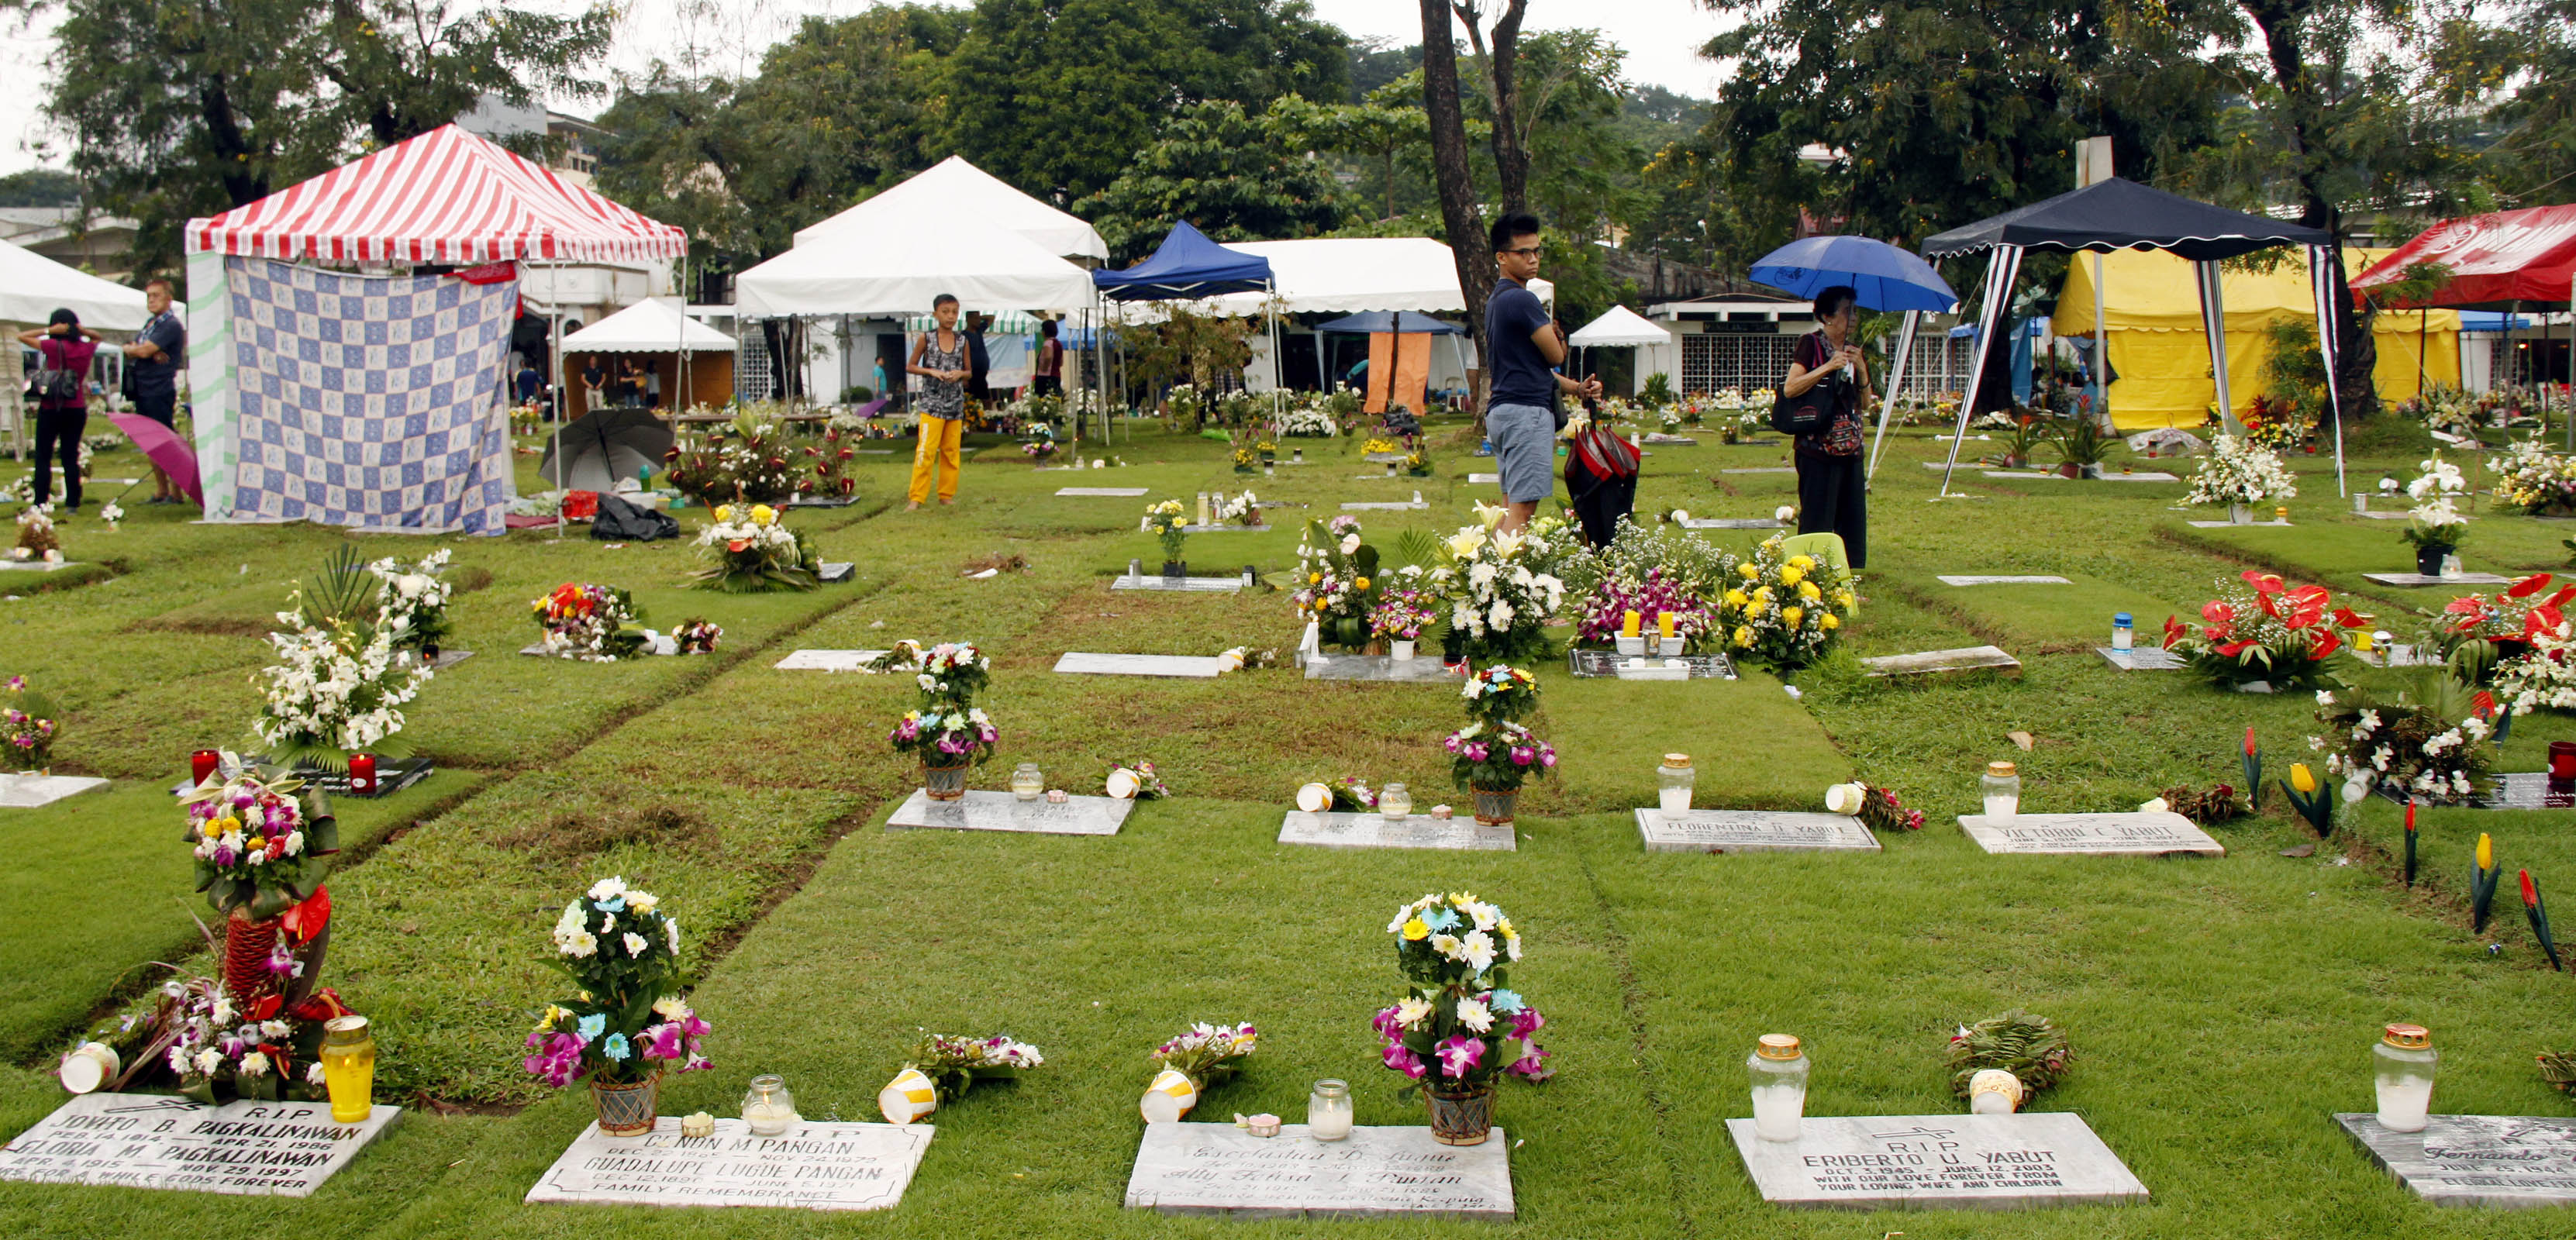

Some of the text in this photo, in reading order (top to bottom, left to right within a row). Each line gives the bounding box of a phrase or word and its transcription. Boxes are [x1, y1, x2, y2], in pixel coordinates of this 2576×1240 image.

[1998, 828, 2086, 838] VICTORIO
[2115, 826, 2174, 836] YABUT
[50, 1114, 362, 1141] JOVITO B. PAGKALINAWAN
[211, 1138, 250, 1147] APR.
[288, 1142, 334, 1151] 1986
[758, 1139, 855, 1155] PANGAN
[16, 1140, 101, 1156] GLORIA
[157, 1145, 335, 1167] PAGKALINAWAN
[1802, 1151, 2057, 1167] ERIBERTO U. YABUT
[2424, 1147, 2548, 1161] Fernando
[81, 1159, 125, 1169] 1915
[178, 1163, 218, 1173] NOV.
[257, 1168, 303, 1177] 1997
[583, 1156, 712, 1176] GUADALUPE
[794, 1165, 884, 1180] PANGAN
[1939, 1172, 2005, 1180] FOREVER
[1942, 1165, 1982, 1173] JUNE
[165, 1173, 217, 1184] GODS
[220, 1176, 308, 1189] FOREVER
[1860, 1182, 1913, 1190] LOVING
[1994, 1179, 2063, 1187] CHILDREN
[2508, 1179, 2547, 1187] LOVE
[592, 1183, 841, 1199] FAMILY REMEMBRANCE
